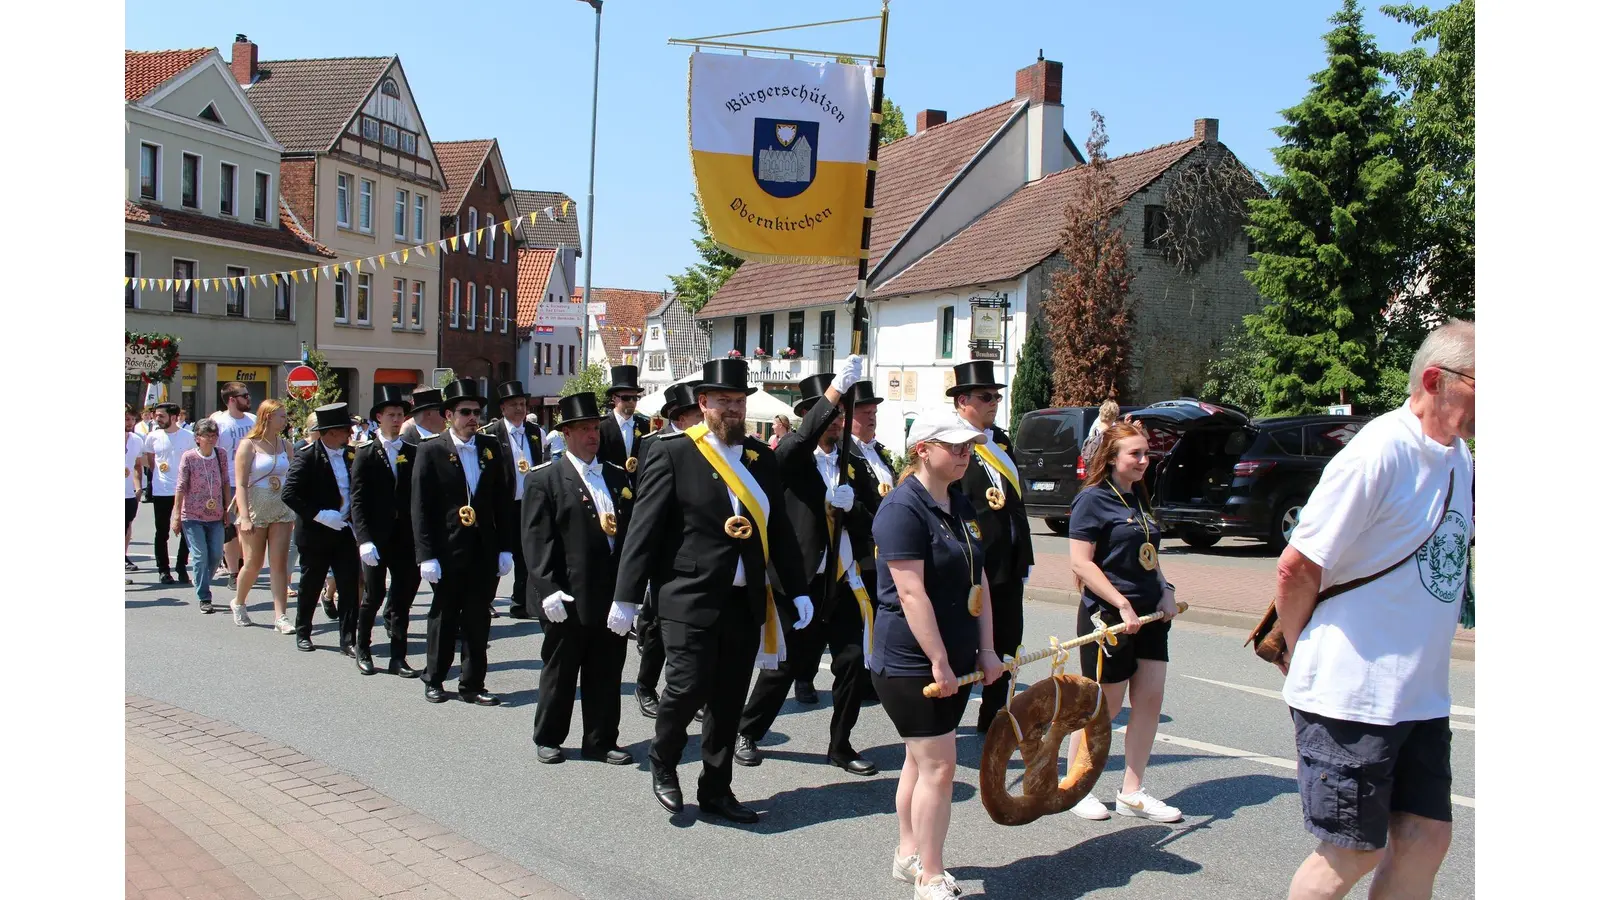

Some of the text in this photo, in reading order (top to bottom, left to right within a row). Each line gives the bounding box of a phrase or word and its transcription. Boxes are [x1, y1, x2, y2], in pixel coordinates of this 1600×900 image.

[725, 84, 845, 123] Bürgerschützen
[730, 197, 833, 231] Obernkirchen
[236, 369, 257, 381] Ernst
